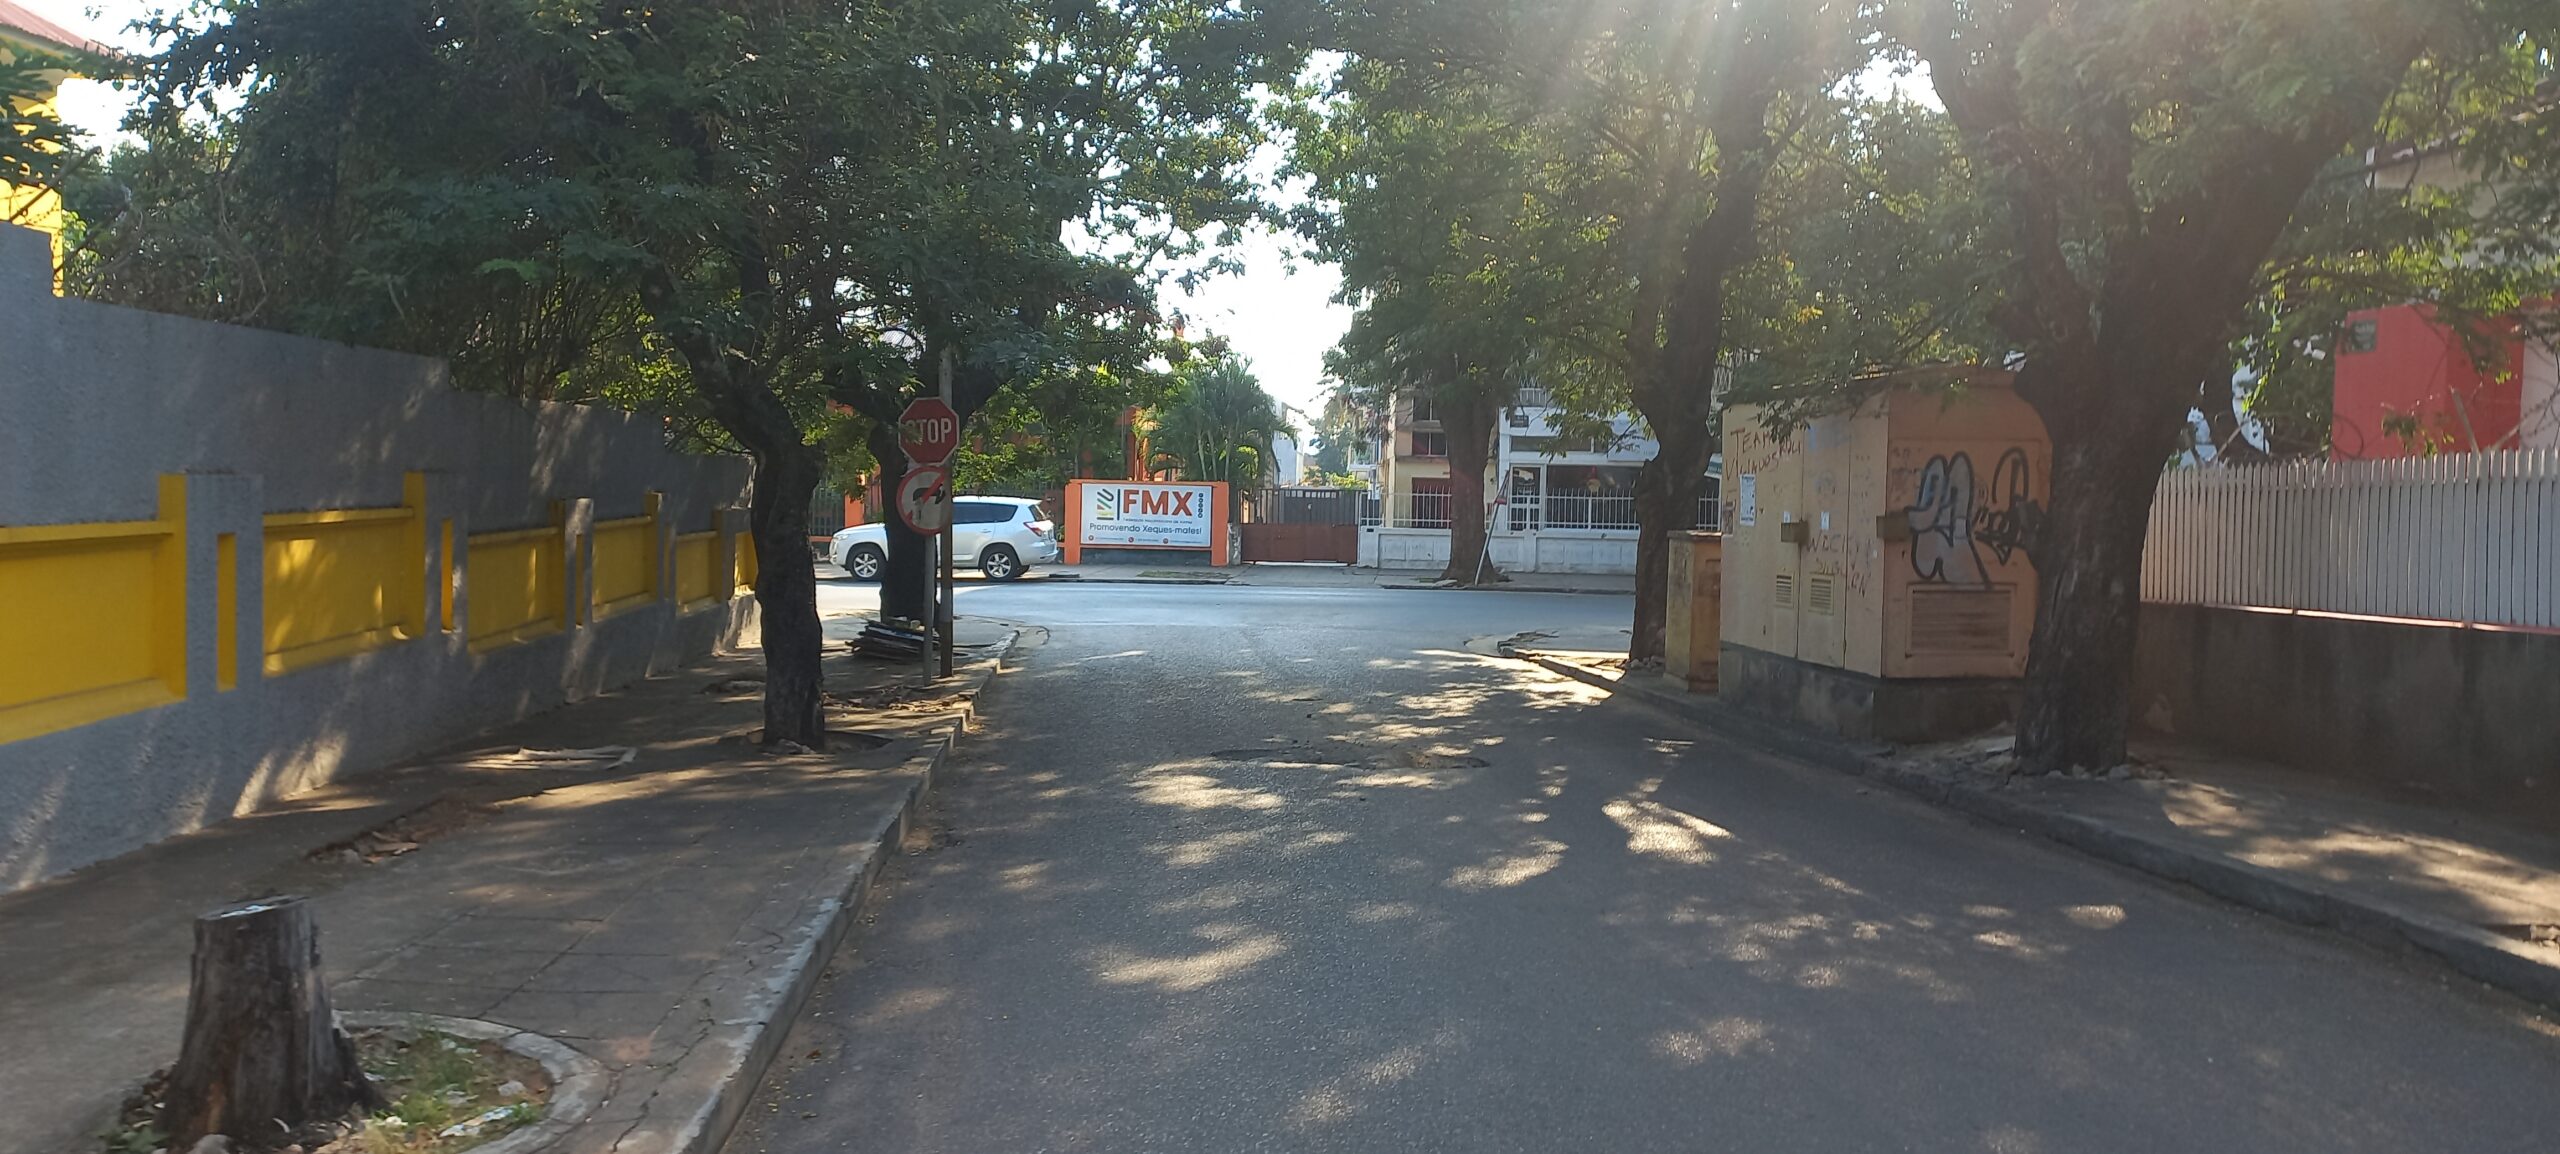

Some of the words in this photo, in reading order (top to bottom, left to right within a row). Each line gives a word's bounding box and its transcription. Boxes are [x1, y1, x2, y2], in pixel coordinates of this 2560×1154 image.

[1123, 489, 1194, 516] FMX
[1089, 522, 1141, 532] Promovendo
[1142, 526, 1202, 535] Xeques-mates!
